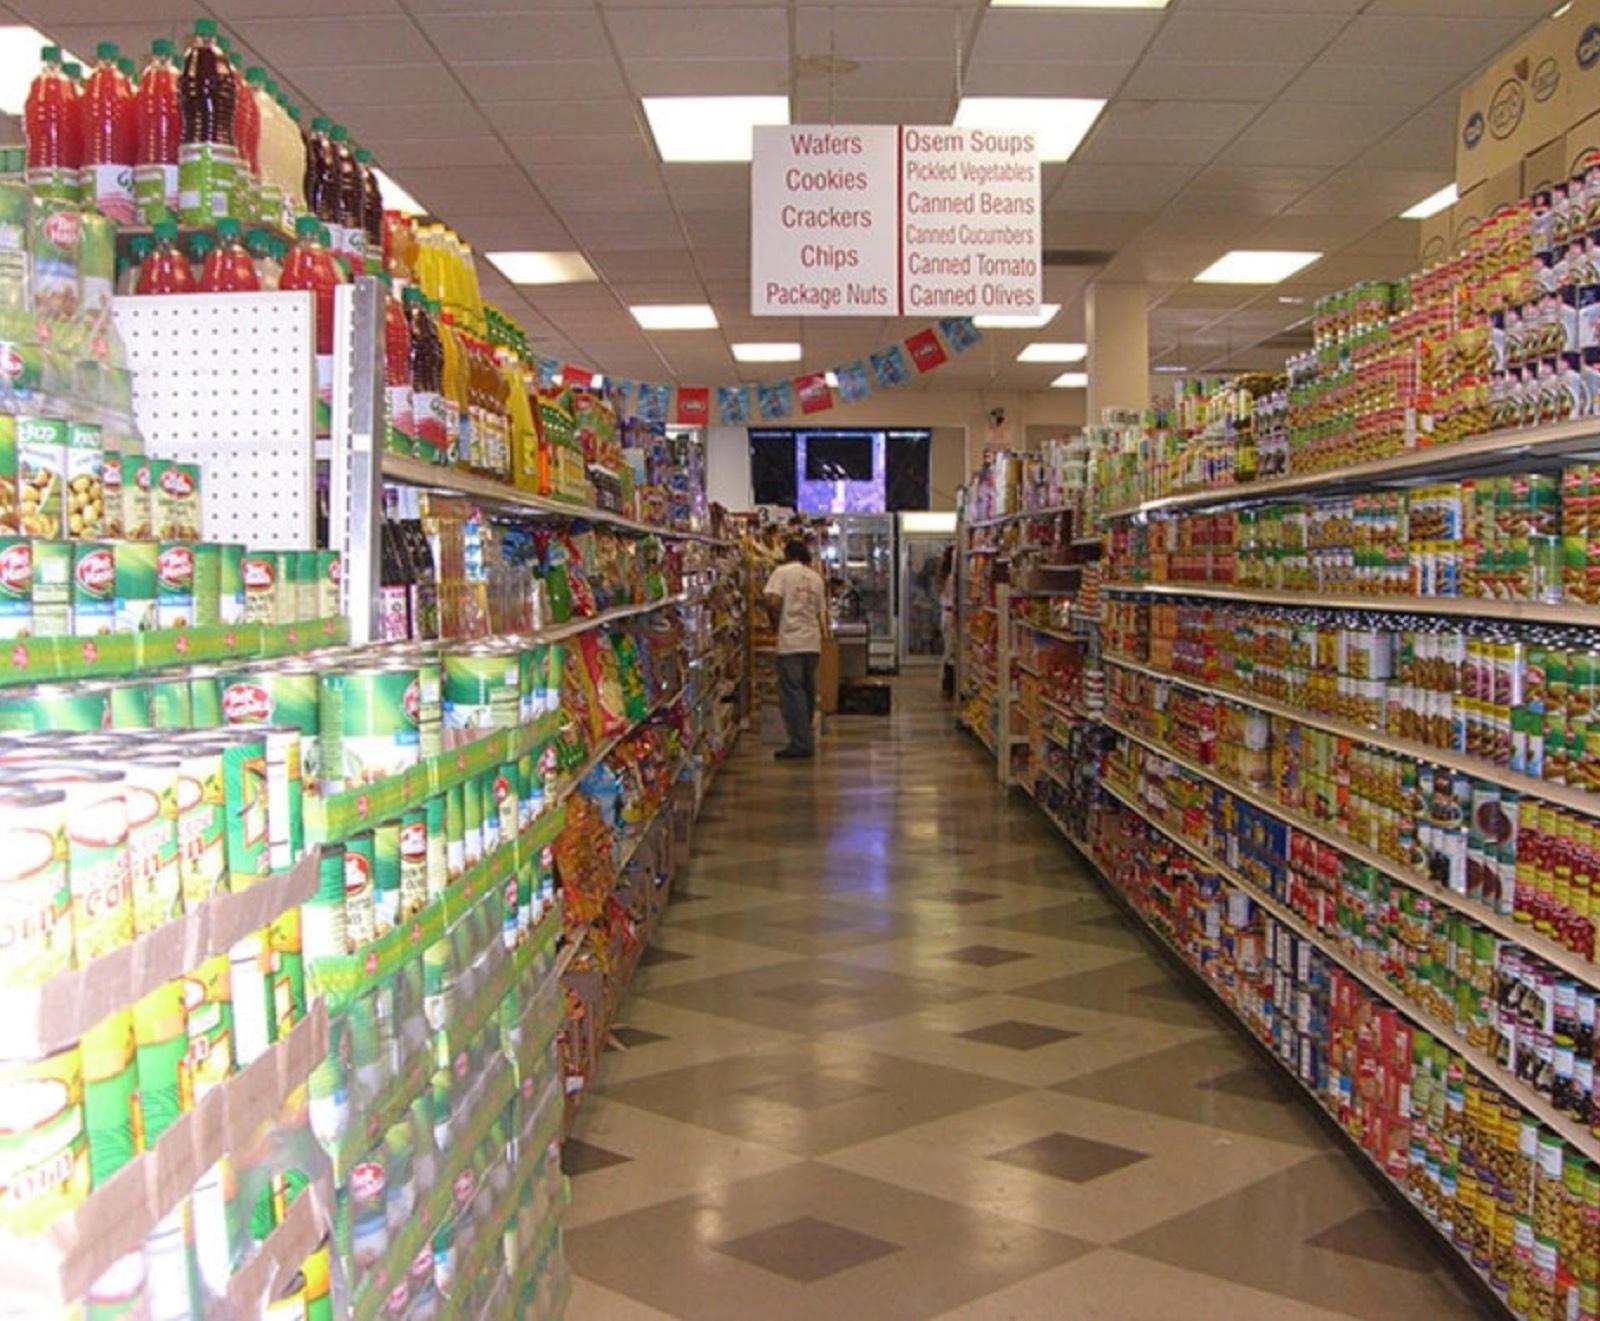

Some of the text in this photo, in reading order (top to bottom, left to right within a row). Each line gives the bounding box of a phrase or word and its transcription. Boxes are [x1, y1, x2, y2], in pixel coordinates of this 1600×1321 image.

[791, 133, 863, 156] Wafers
[905, 130, 1035, 156] Osem Soups
[785, 168, 868, 192] Cookies
[907, 161, 1034, 186] Pickled Vegetables
[907, 191, 1035, 215] Canned Beans
[781, 205, 872, 229] Crackers
[906, 224, 1034, 246] Canned Cucumbers
[801, 244, 859, 271] Chips
[909, 252, 1037, 277] Canned Tomato
[766, 282, 888, 310] Package Nuts
[910, 284, 1035, 307] Canned Olives
